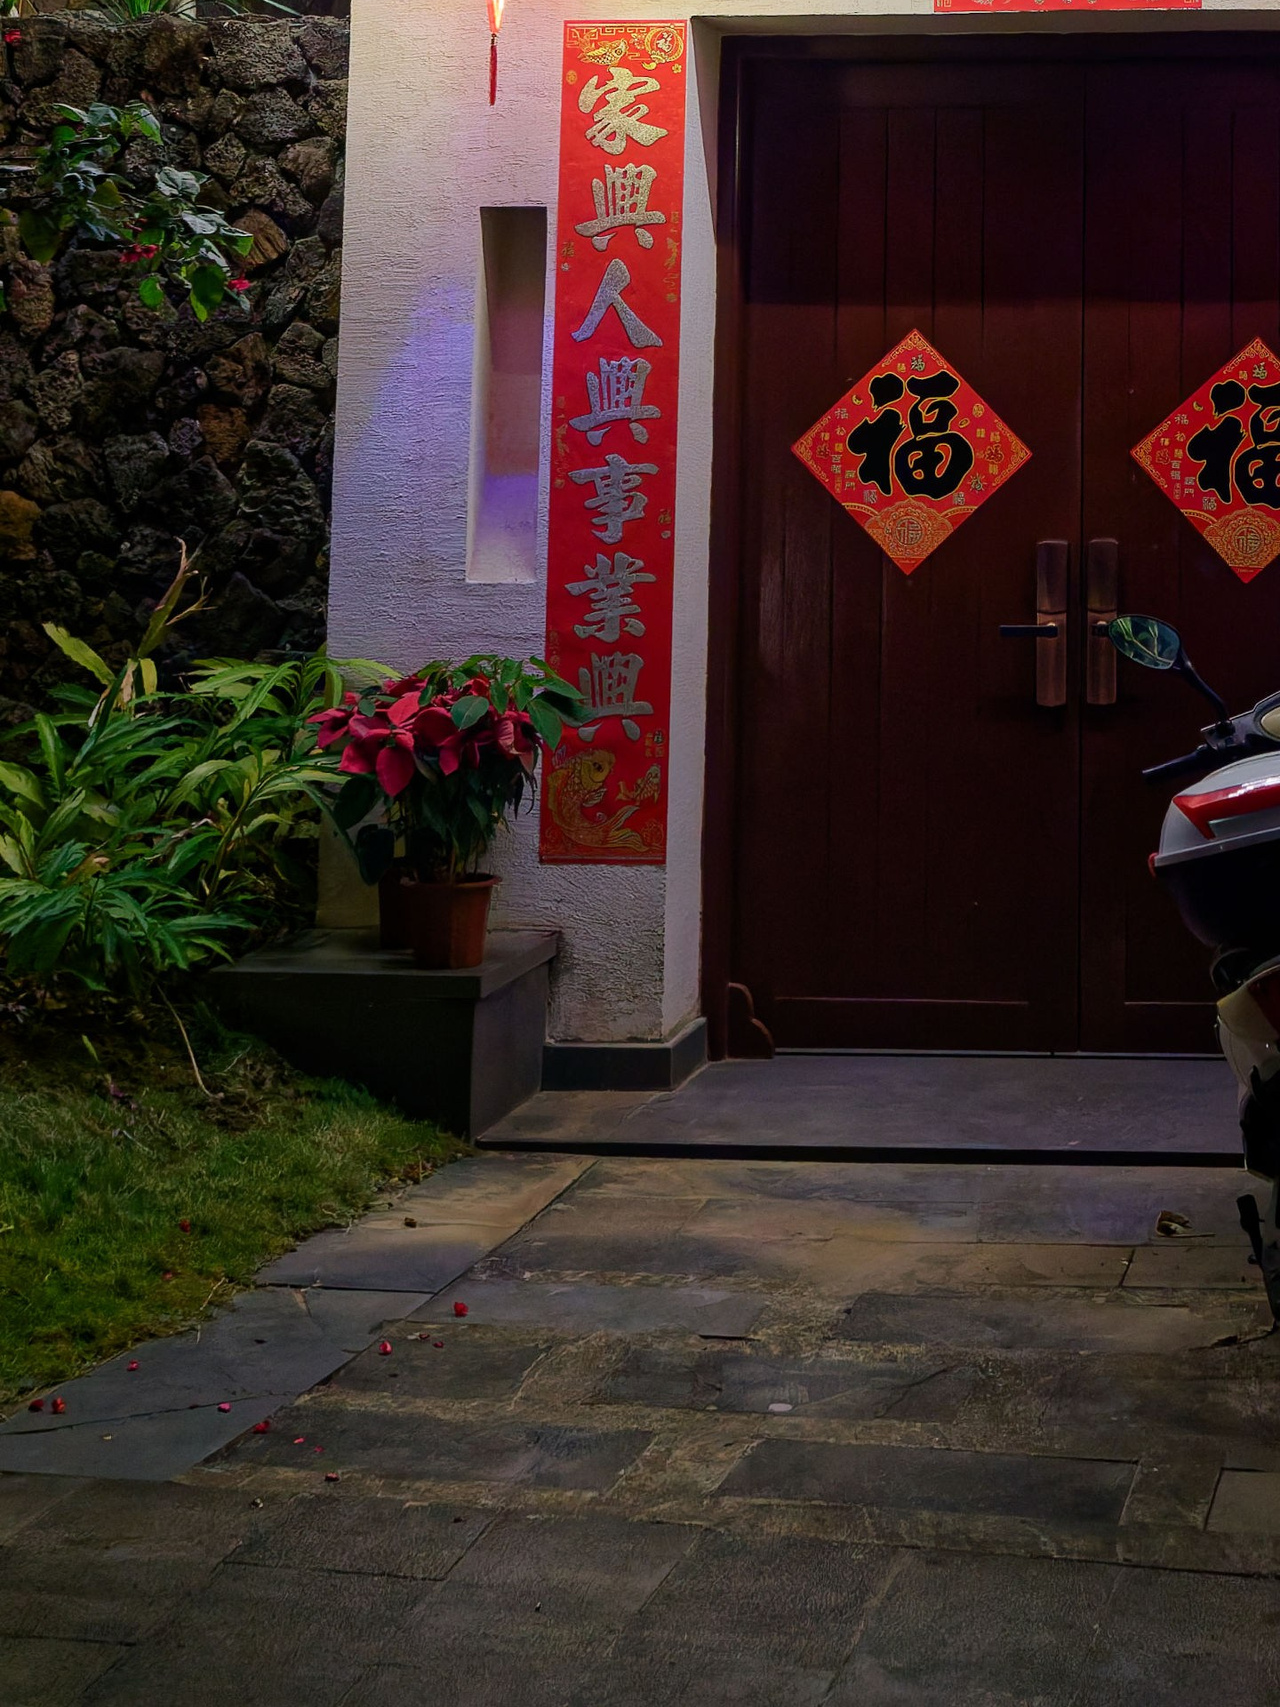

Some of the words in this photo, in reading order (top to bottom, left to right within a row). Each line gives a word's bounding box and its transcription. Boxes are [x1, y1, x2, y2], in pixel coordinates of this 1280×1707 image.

[563, 66, 670, 742] 家興人興事業興
[845, 369, 975, 499] 福
